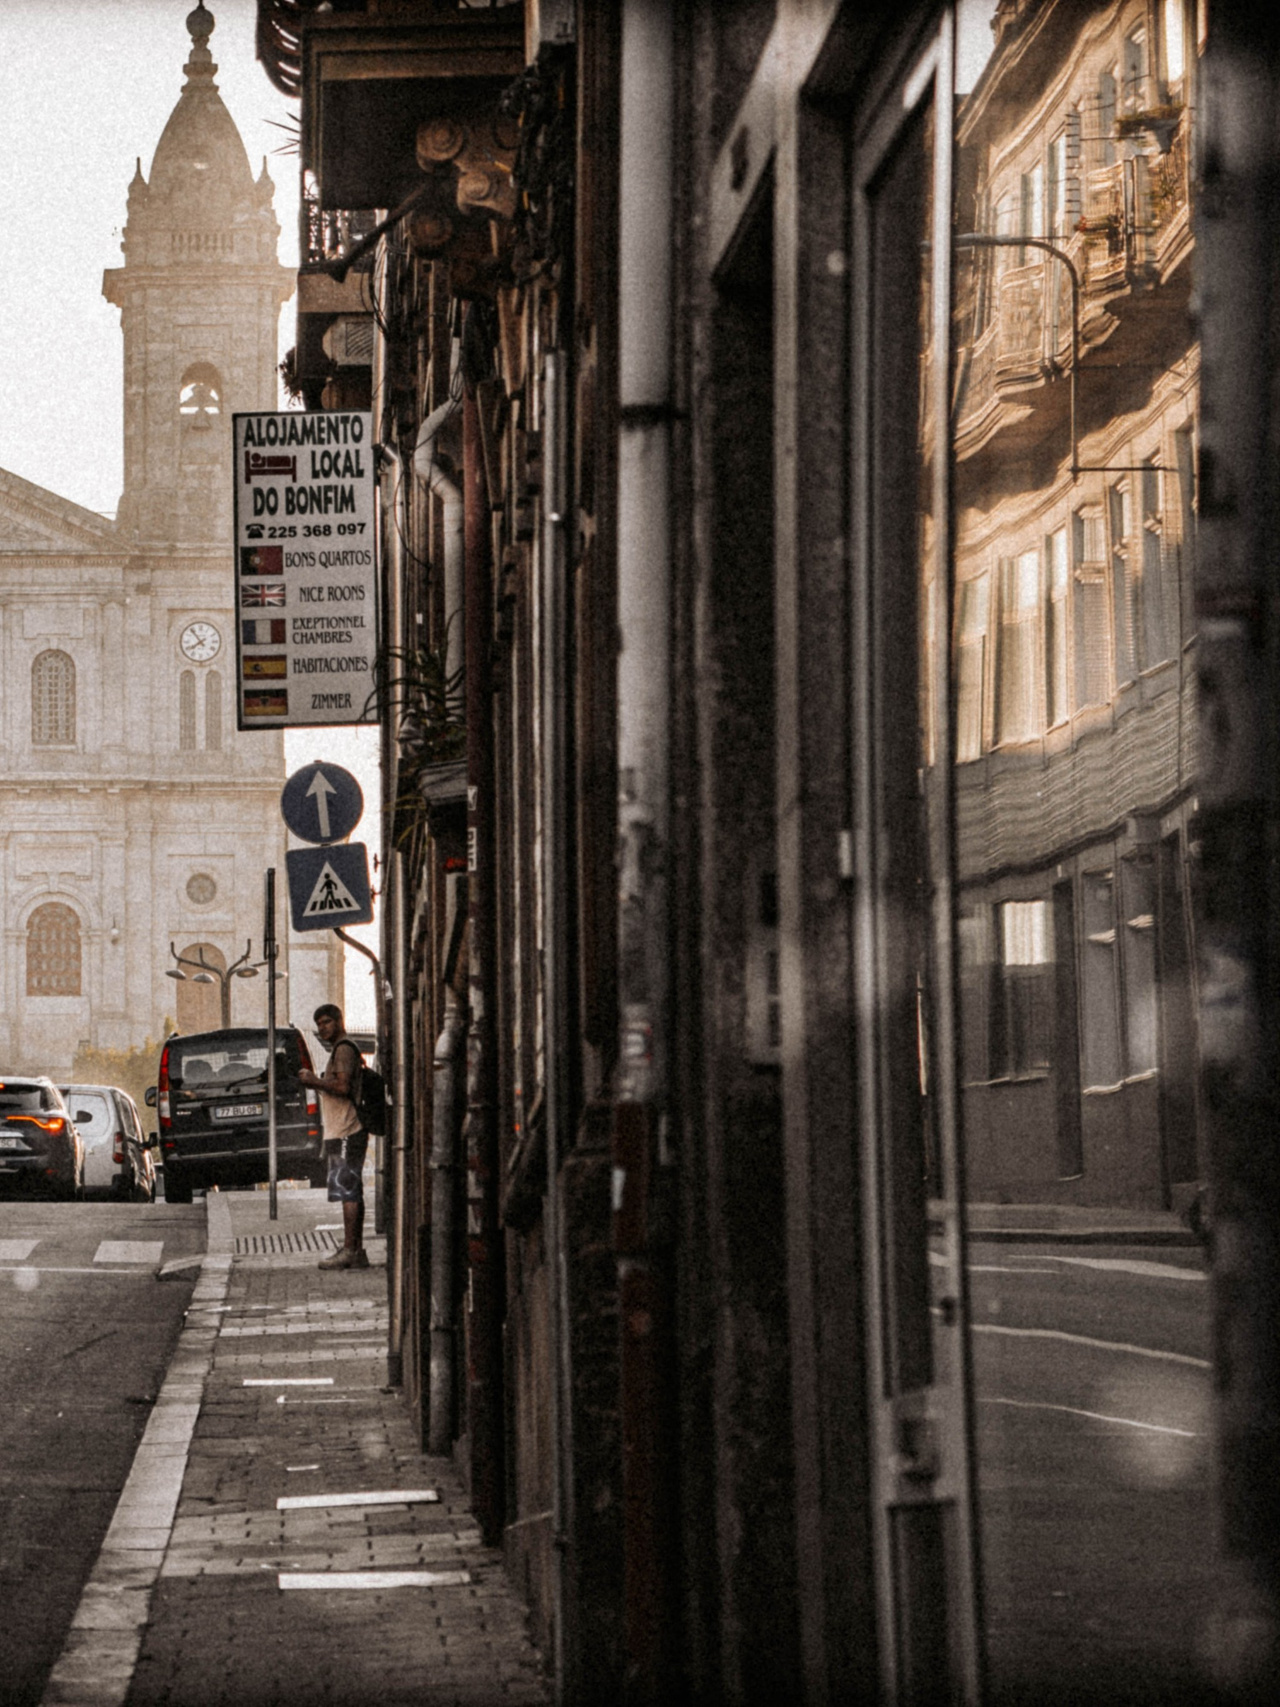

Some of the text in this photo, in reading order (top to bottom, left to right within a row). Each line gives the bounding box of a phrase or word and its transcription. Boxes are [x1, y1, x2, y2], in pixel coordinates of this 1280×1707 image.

[243, 414, 364, 448] ALOJAMENTO
[311, 448, 365, 479] LOCAL
[253, 484, 356, 517] DO BONFIM
[267, 522, 367, 539] 225 368 097
[284, 549, 372, 569] BONS QUARTOS
[299, 584, 366, 603] NICE ROONS
[292, 615, 367, 630] EXEPTIONNEL
[292, 630, 353, 645] CHAMBRES
[293, 655, 369, 674] HABITACIONES
[311, 692, 352, 710] ZIMMER
